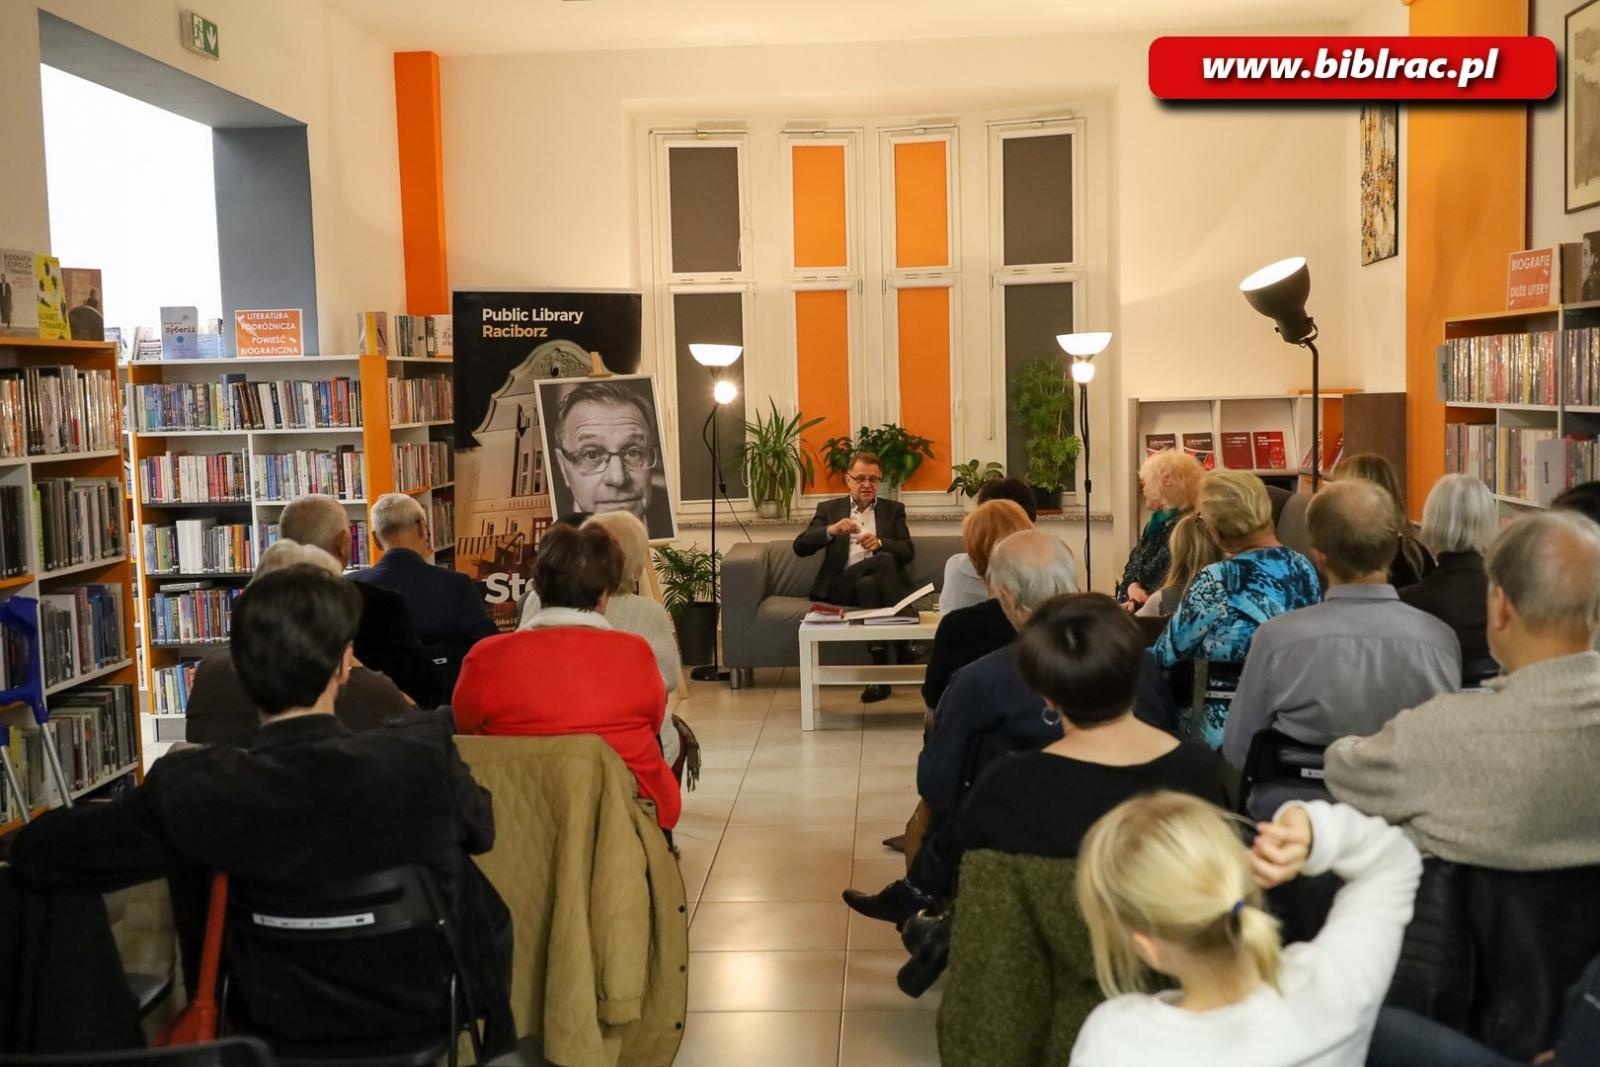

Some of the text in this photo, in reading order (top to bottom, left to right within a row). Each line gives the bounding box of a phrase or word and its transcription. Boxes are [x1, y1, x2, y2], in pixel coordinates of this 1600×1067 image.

[1511, 254, 1551, 271] BIOGRAFIE
[1527, 283, 1550, 296] LITERY
[247, 312, 289, 320] LITERATURA
[482, 307, 584, 324] Public Library
[482, 324, 548, 338] Raciborz
[252, 334, 287, 344] POWIEŚĆ
[240, 346, 298, 355] BIOGRAFICZNA
[484, 572, 534, 604] St
